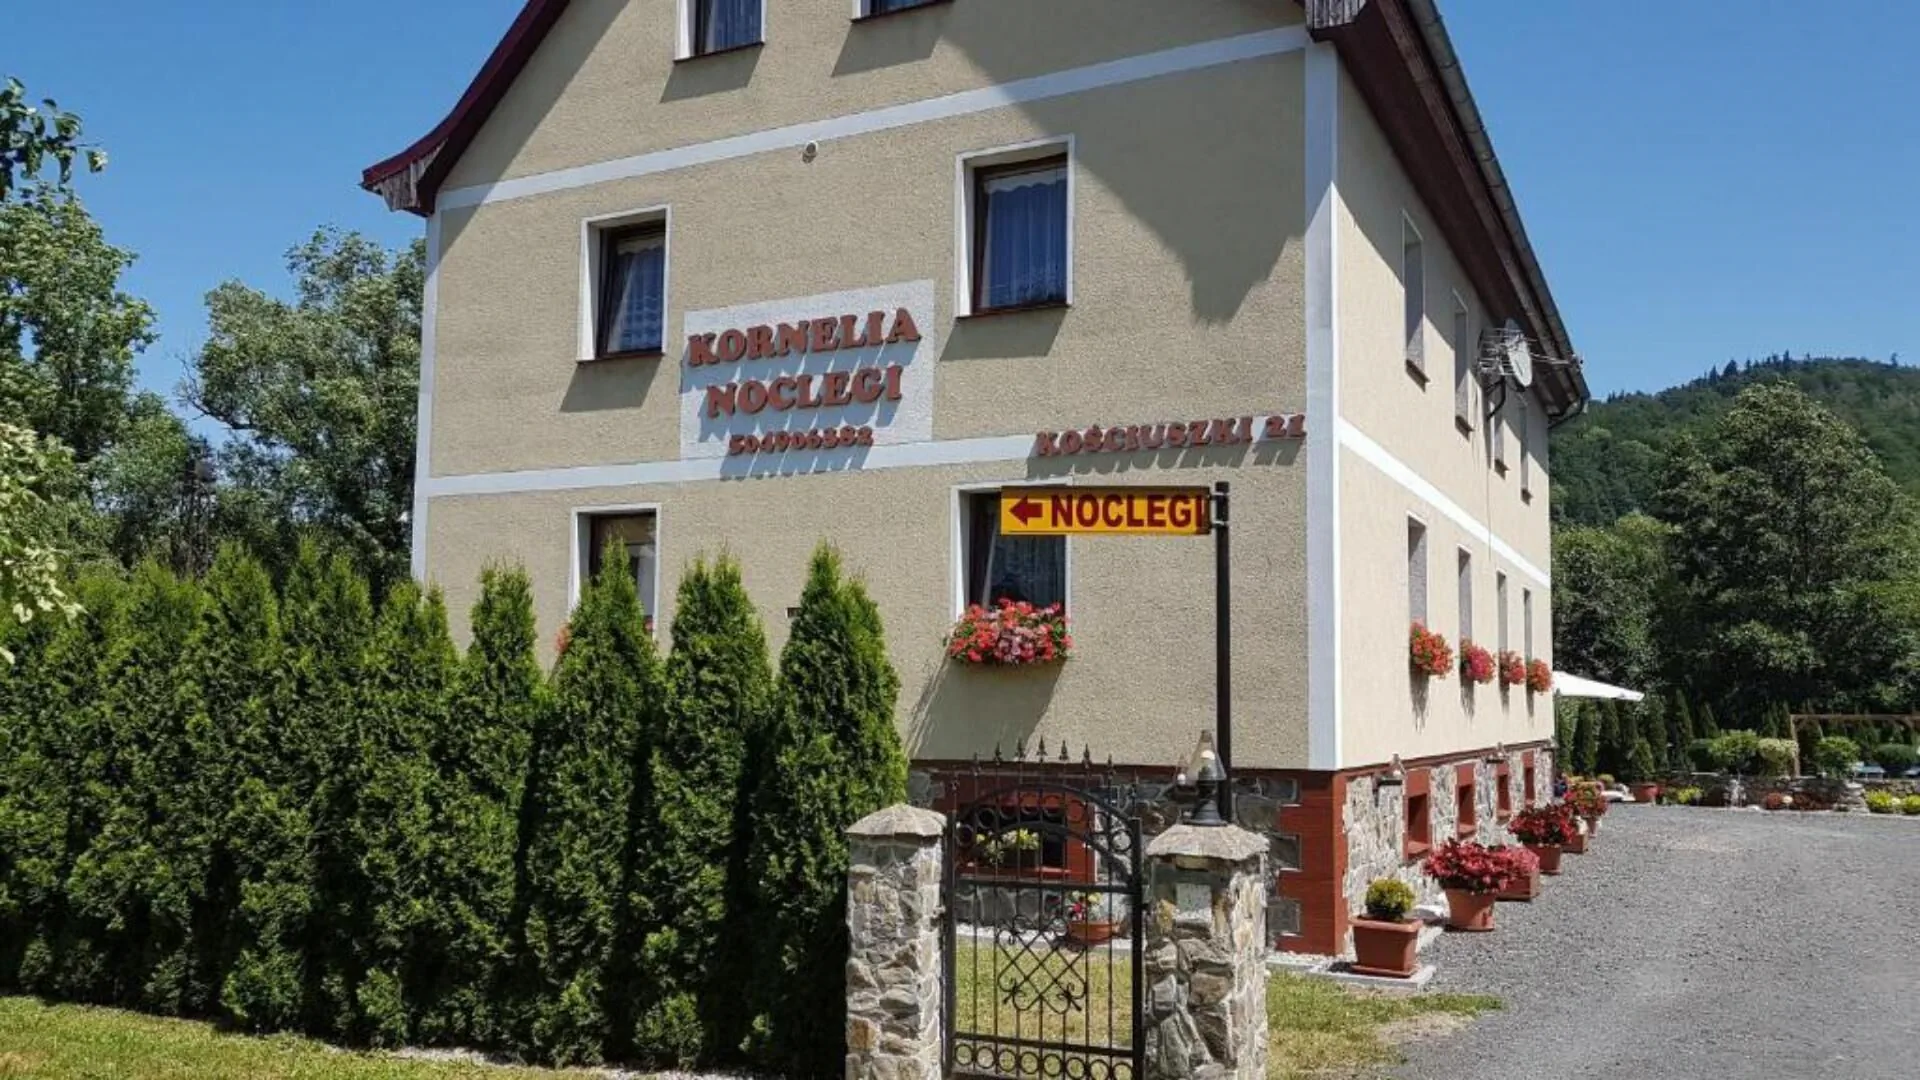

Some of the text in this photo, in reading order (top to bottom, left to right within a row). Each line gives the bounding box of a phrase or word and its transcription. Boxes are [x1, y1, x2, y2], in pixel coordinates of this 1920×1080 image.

[687, 307, 921, 366] KORNELIA
[706, 365, 903, 418] NOCLEGI
[1034, 413, 1307, 457] KOŚCIUSZKI 21
[1051, 494, 1204, 528] NOCLEGI
